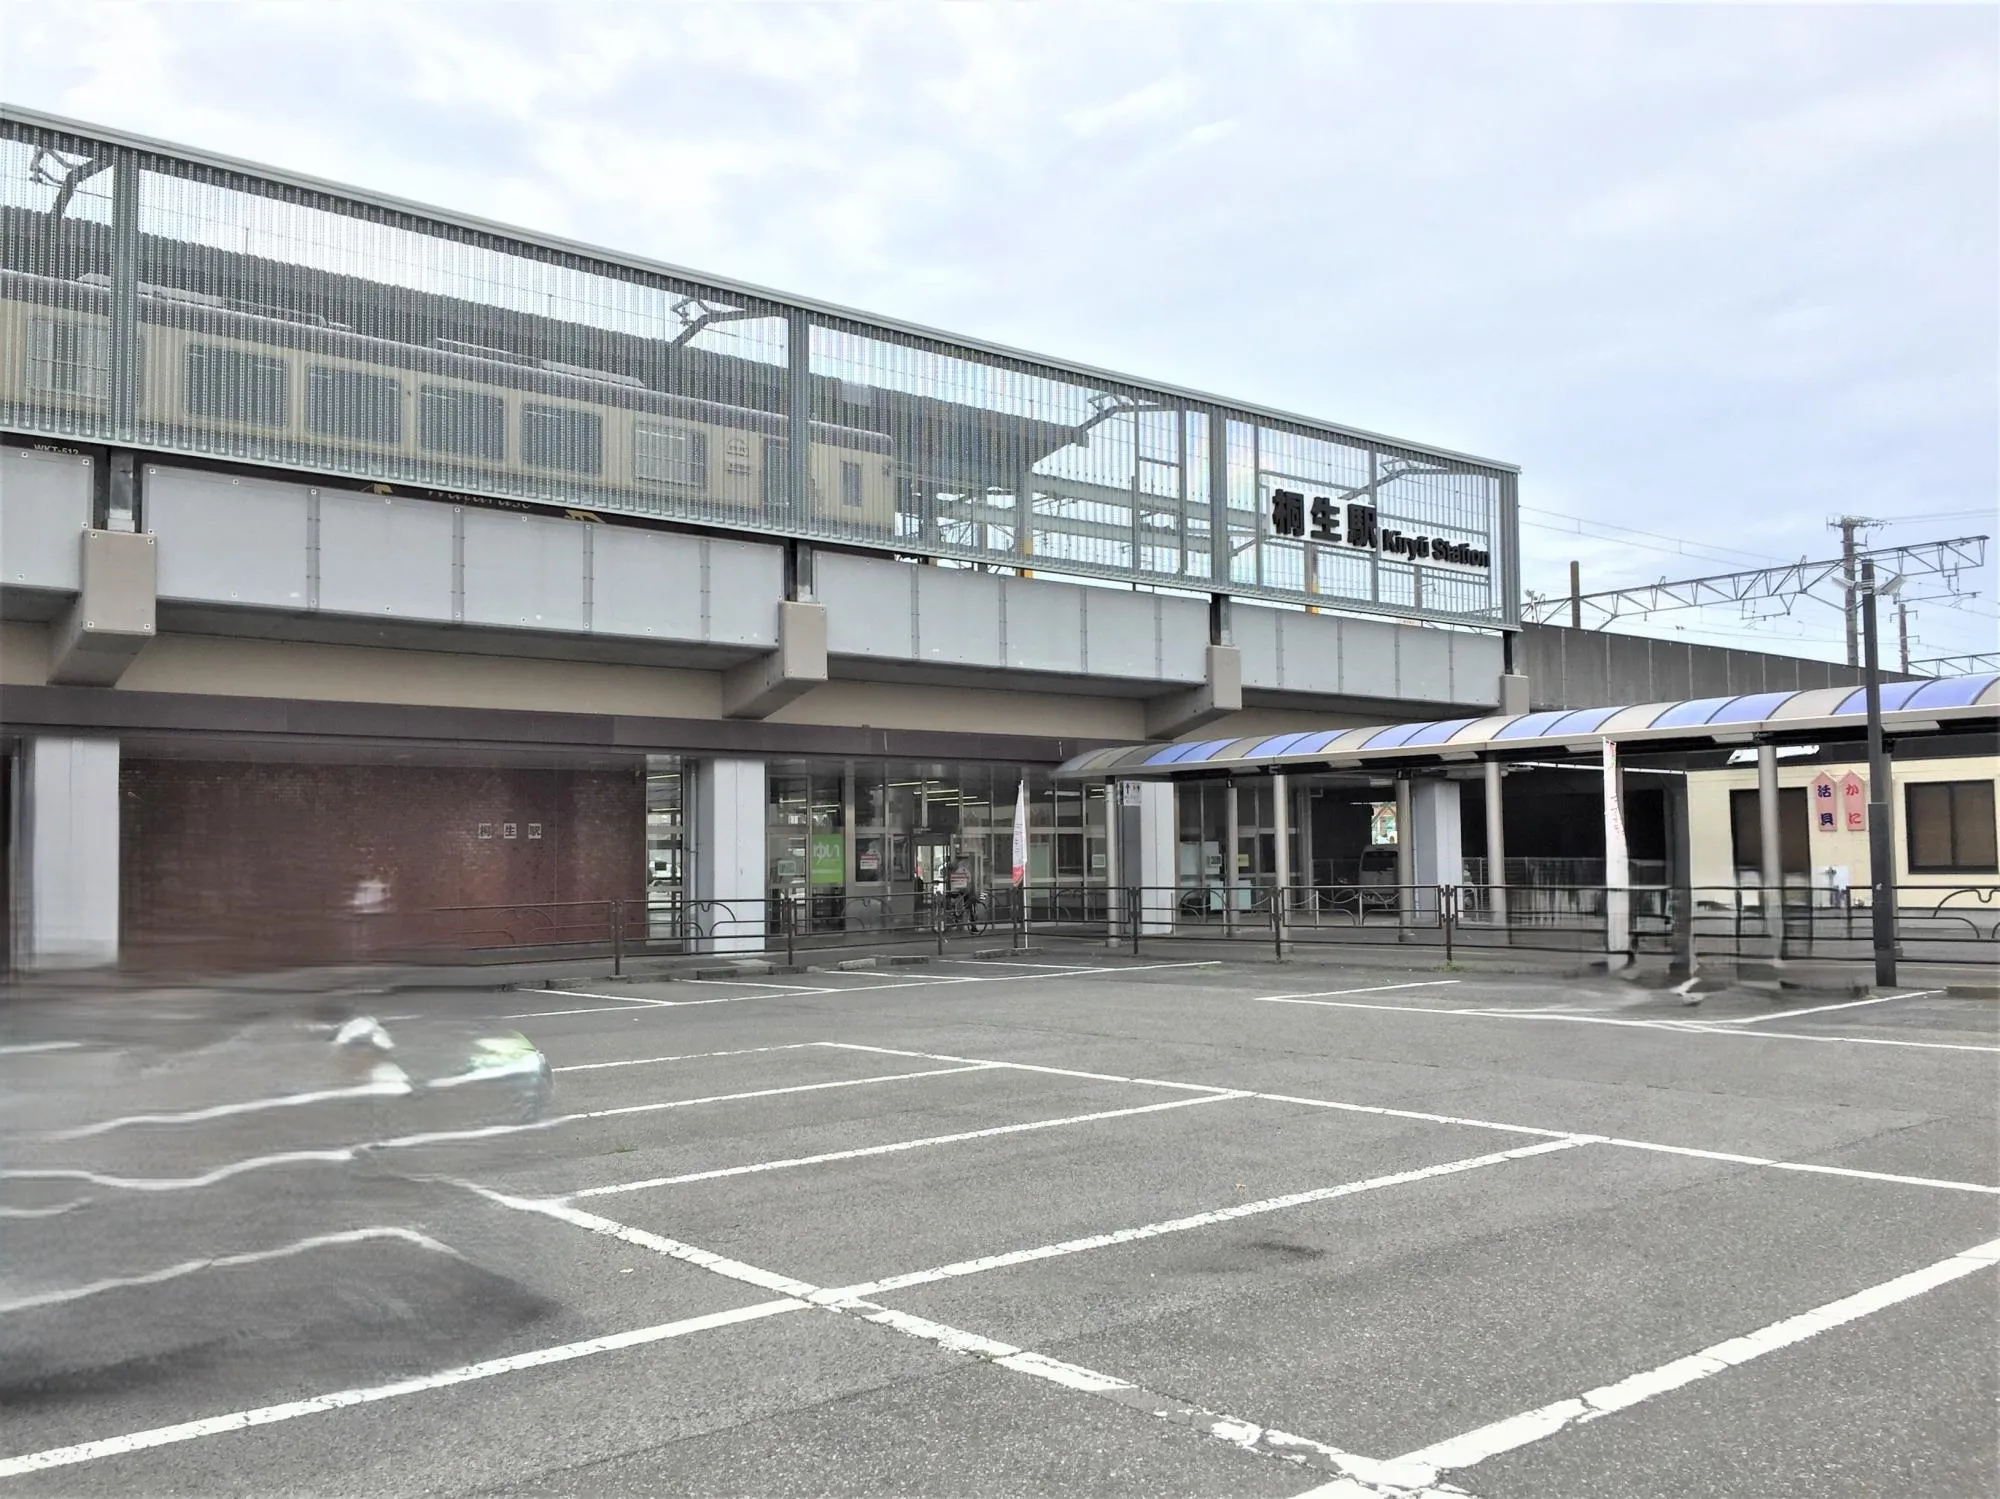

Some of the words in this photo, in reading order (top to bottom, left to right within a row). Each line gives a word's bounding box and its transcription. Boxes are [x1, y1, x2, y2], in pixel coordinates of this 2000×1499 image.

[1272, 489, 1377, 548] 桐生駅
[1431, 538, 1490, 568] Station
[1817, 784, 1834, 826] 活貝
[1846, 784, 1862, 825] かに
